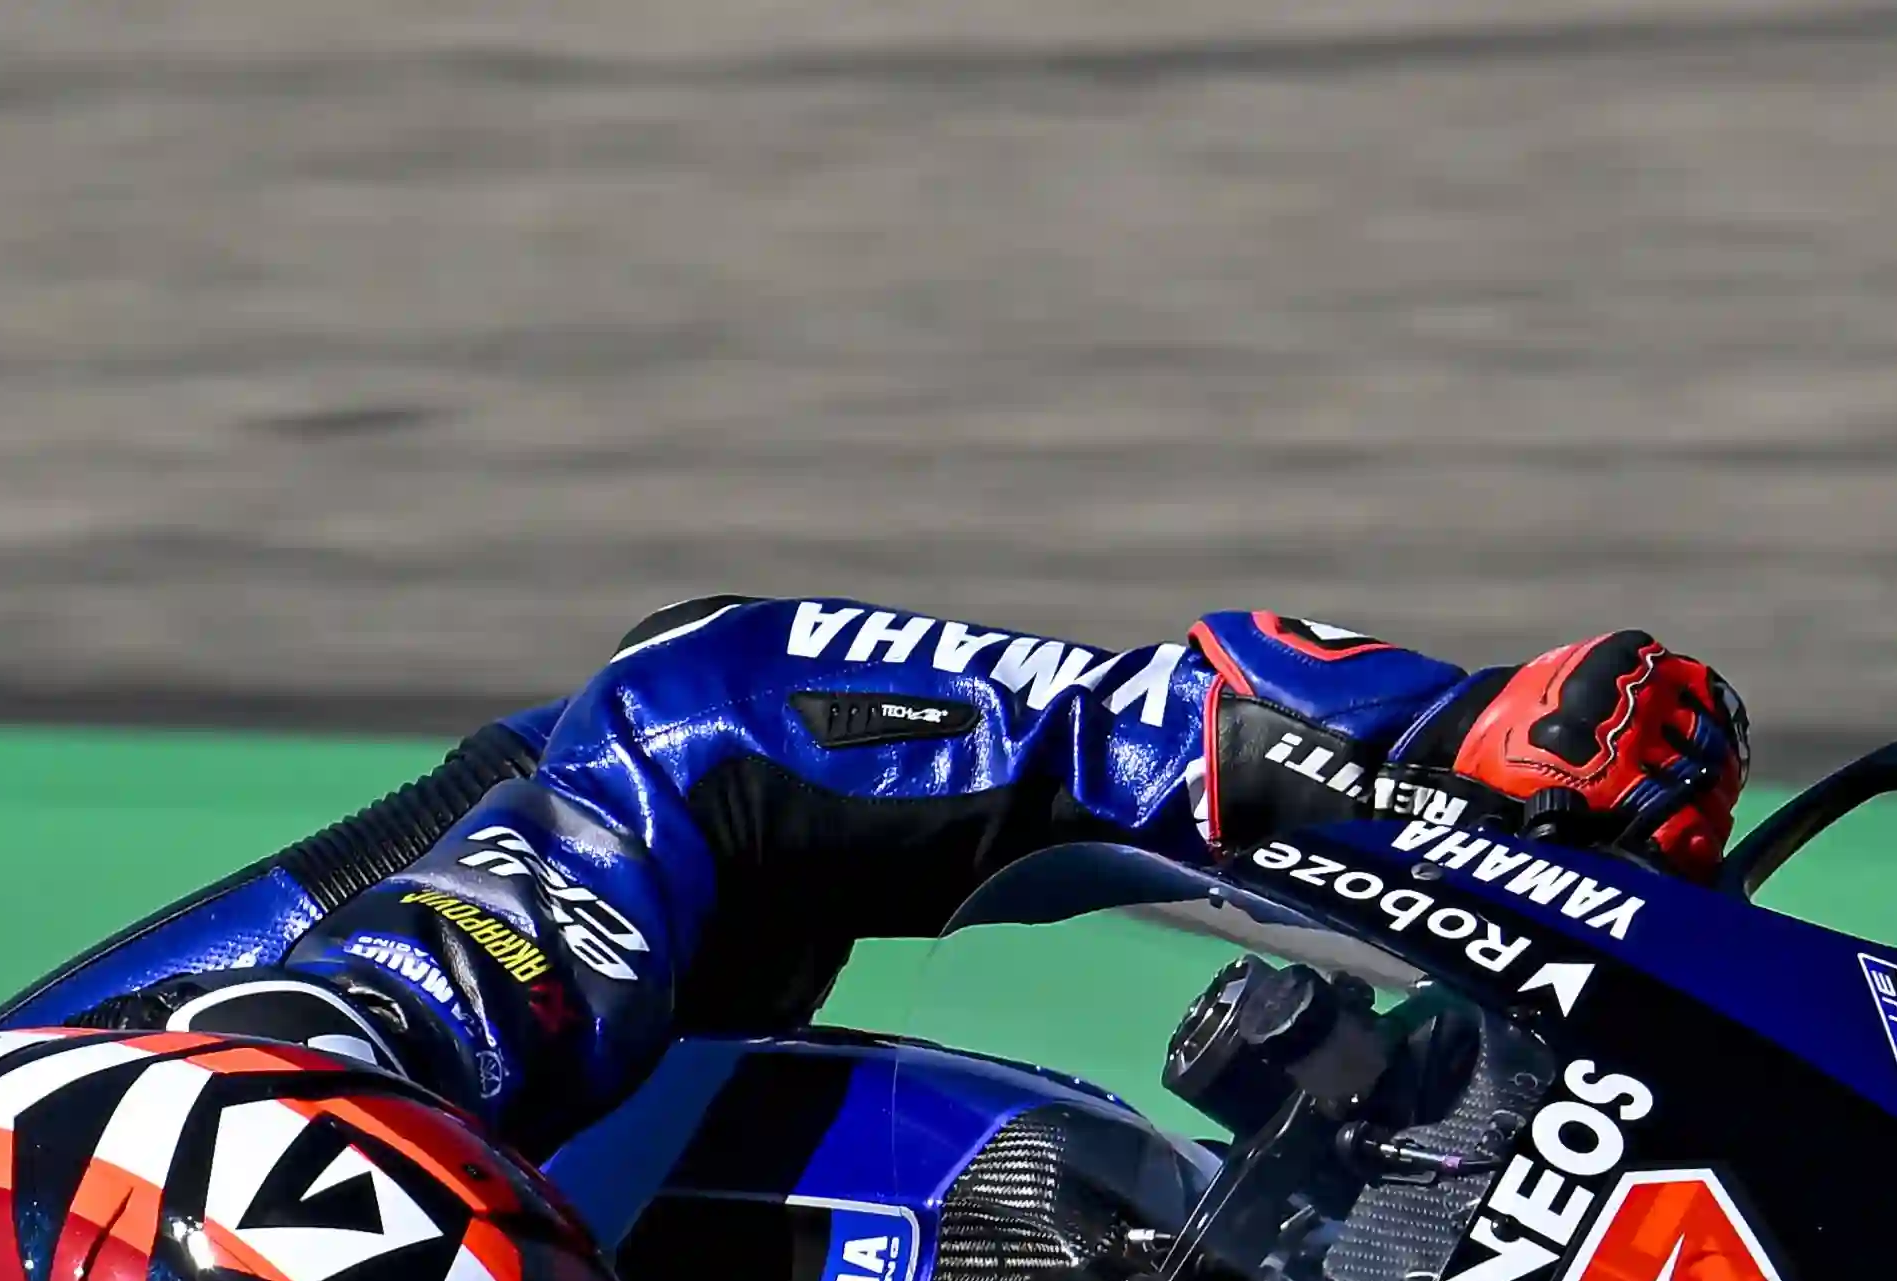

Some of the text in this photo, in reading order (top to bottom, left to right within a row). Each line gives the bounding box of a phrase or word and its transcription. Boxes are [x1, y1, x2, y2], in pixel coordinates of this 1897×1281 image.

[787, 601, 1185, 726] YAMAHA
[1252, 840, 1532, 974] Roboze
[1391, 820, 1646, 940] YAMAHA
